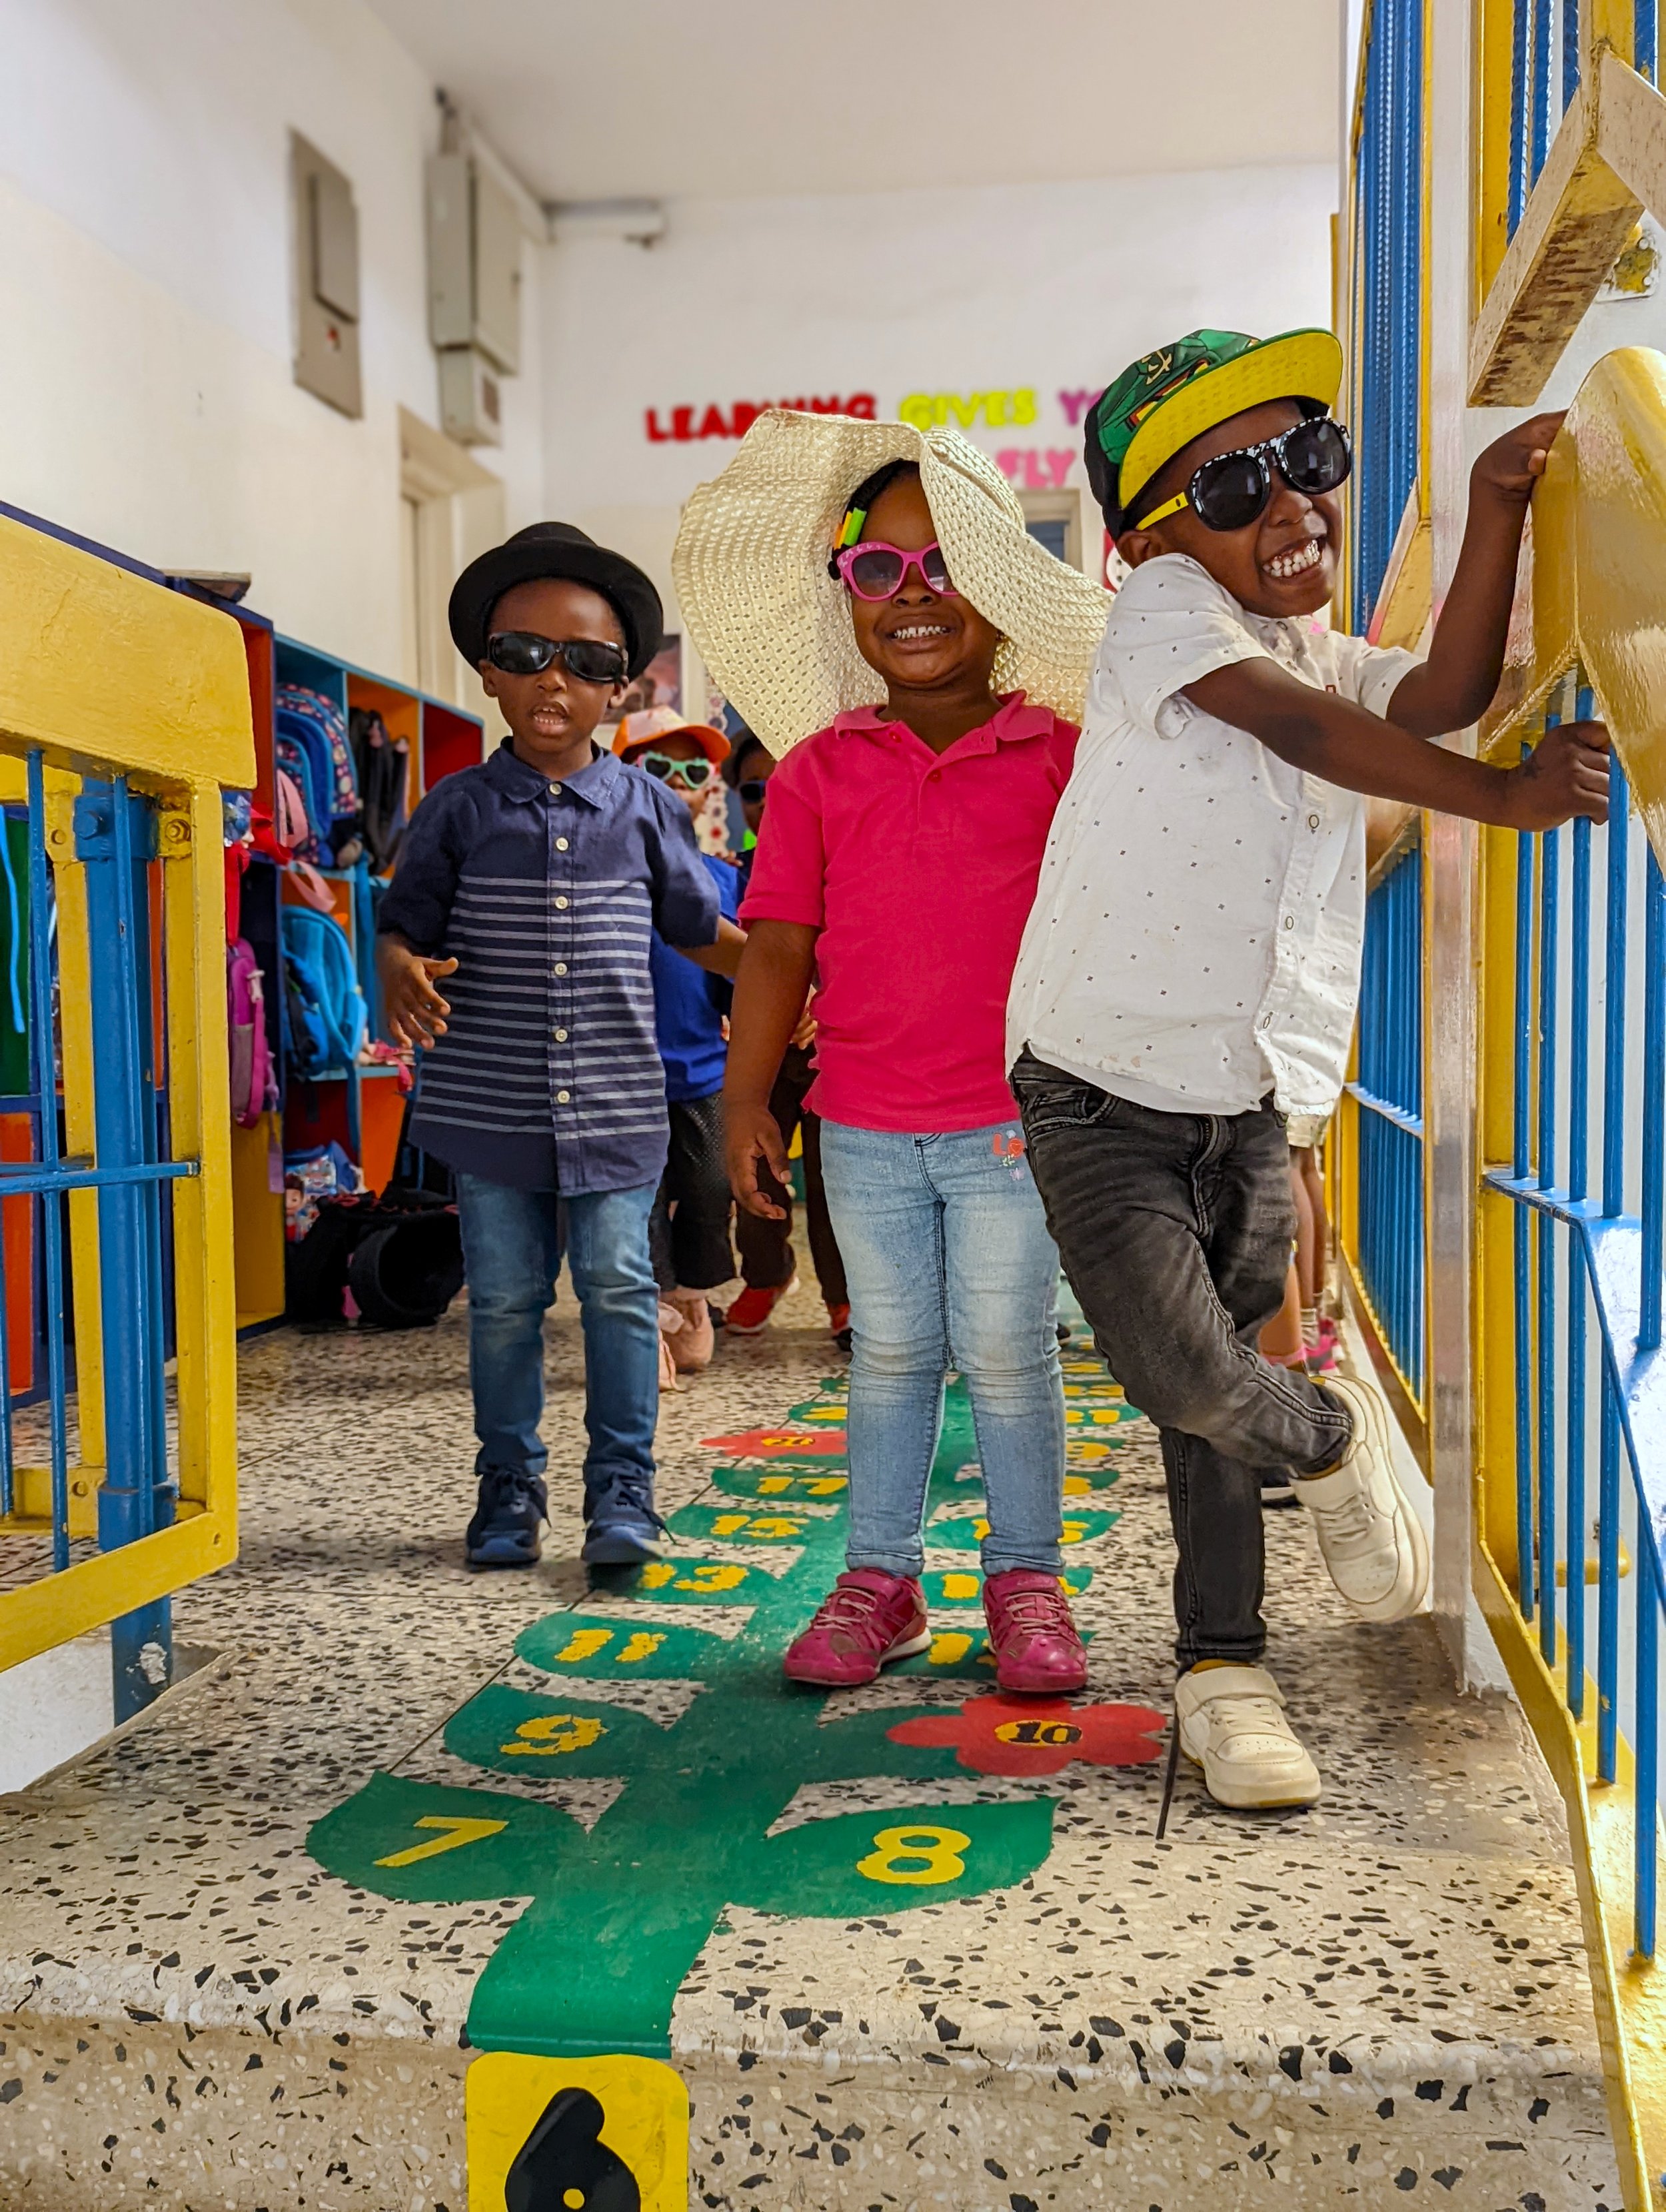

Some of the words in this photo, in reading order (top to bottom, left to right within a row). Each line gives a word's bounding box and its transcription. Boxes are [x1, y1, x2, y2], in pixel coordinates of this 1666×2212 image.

[900, 388, 1038, 432] GIVES
[1059, 388, 1104, 426] Y
[500, 1714, 609, 1756] 9
[1007, 1721, 1082, 1744] 10
[373, 1816, 509, 1866] 7
[856, 1826, 972, 1884] 8
[504, 2087, 642, 2212] 6
